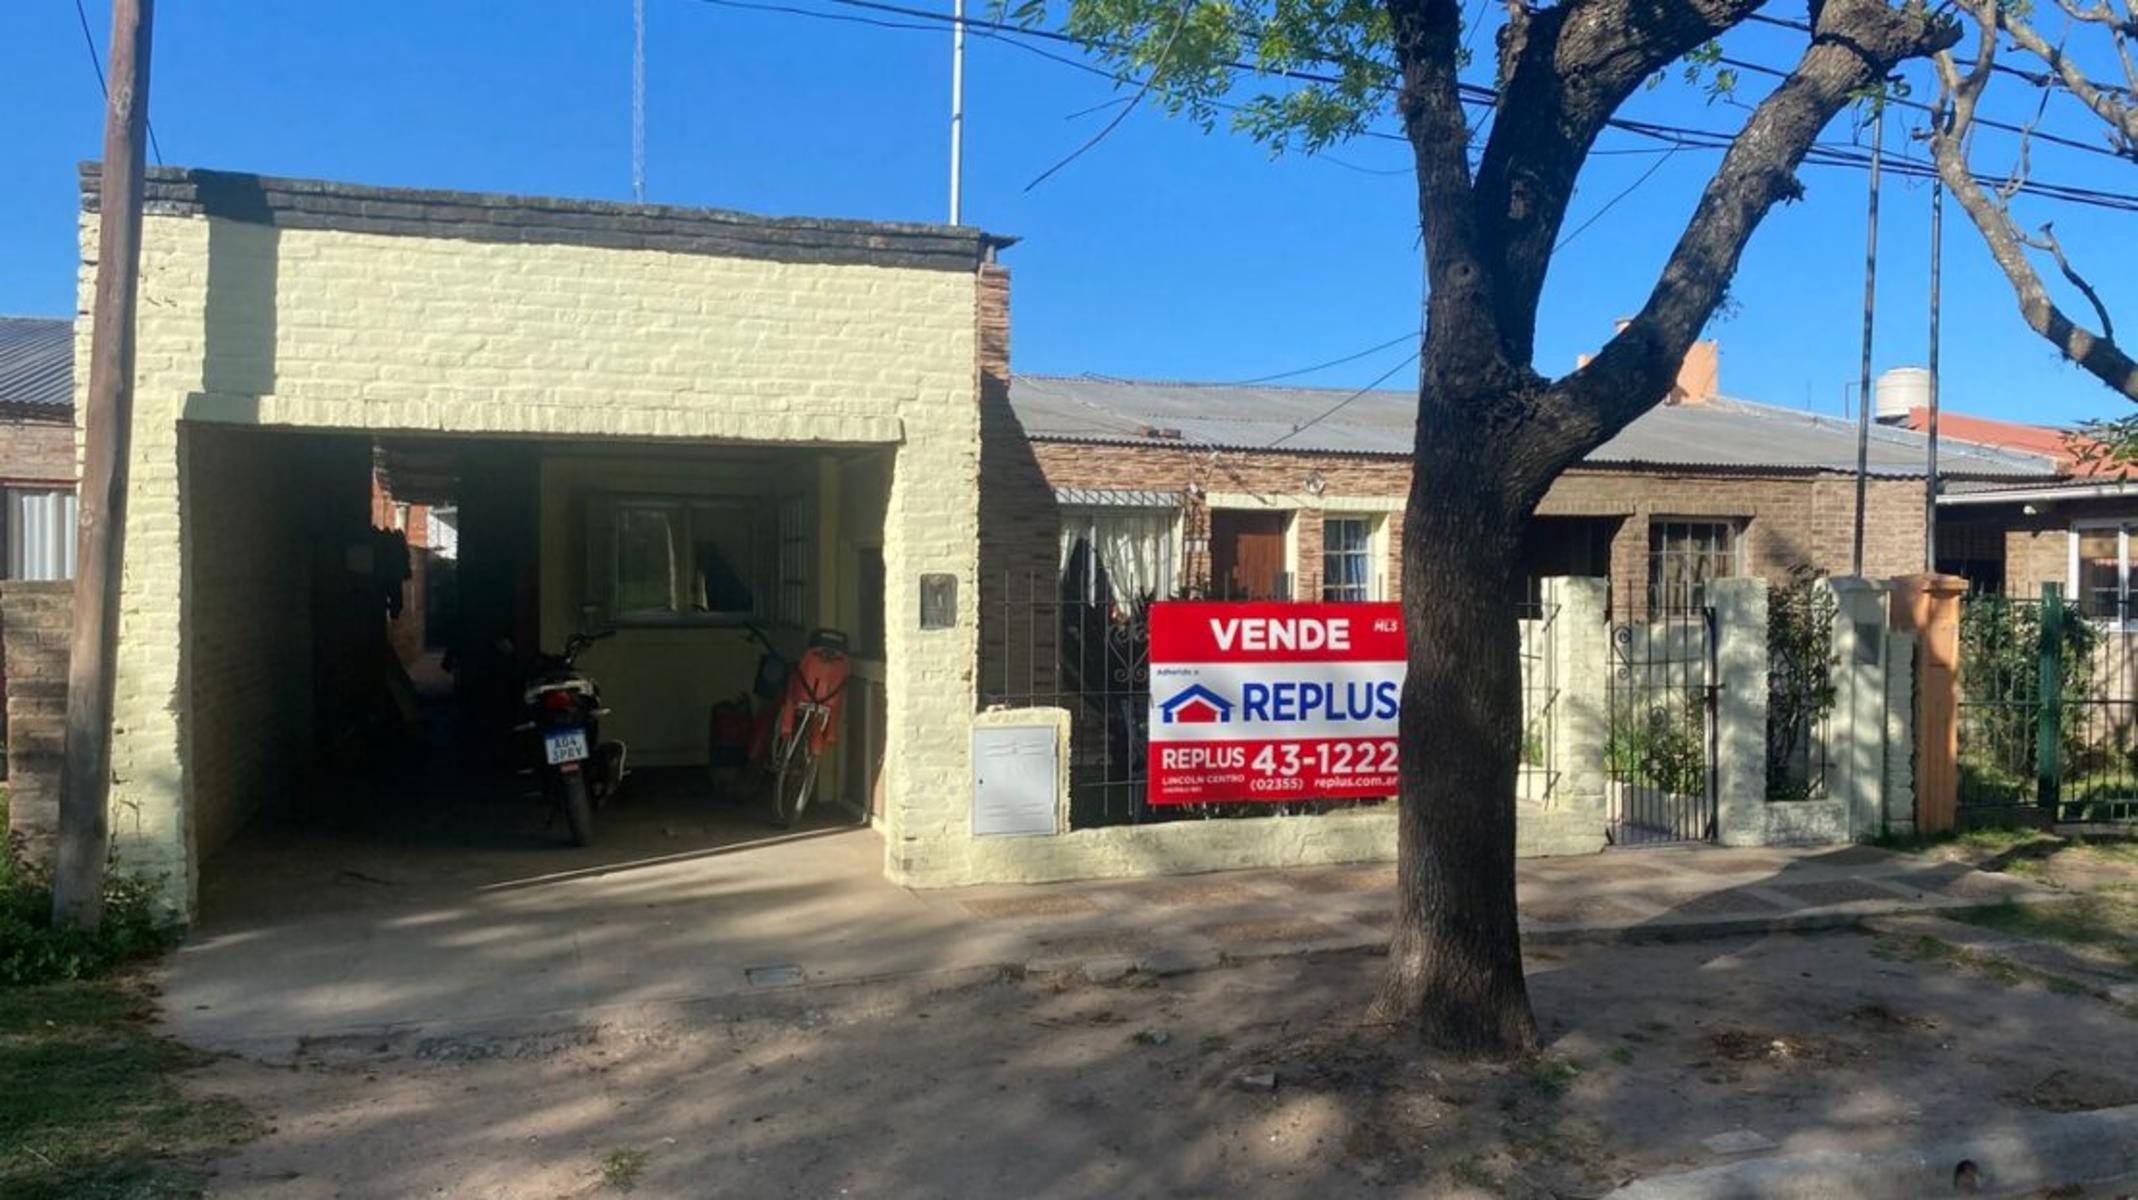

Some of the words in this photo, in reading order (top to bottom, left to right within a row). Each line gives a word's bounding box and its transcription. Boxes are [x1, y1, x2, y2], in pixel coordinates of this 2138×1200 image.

[1210, 618, 1350, 651] VENDE
[1242, 681, 1397, 722] REPLUS
[1162, 747, 1245, 769] REPLUS
[1251, 742, 1398, 776] 43-1222
[1162, 775, 1204, 785] LINCOLN
[1206, 774, 1245, 784] CENTRO
[1250, 778, 1303, 791] (02355)
[1314, 776, 1398, 789] replus.com.ar
